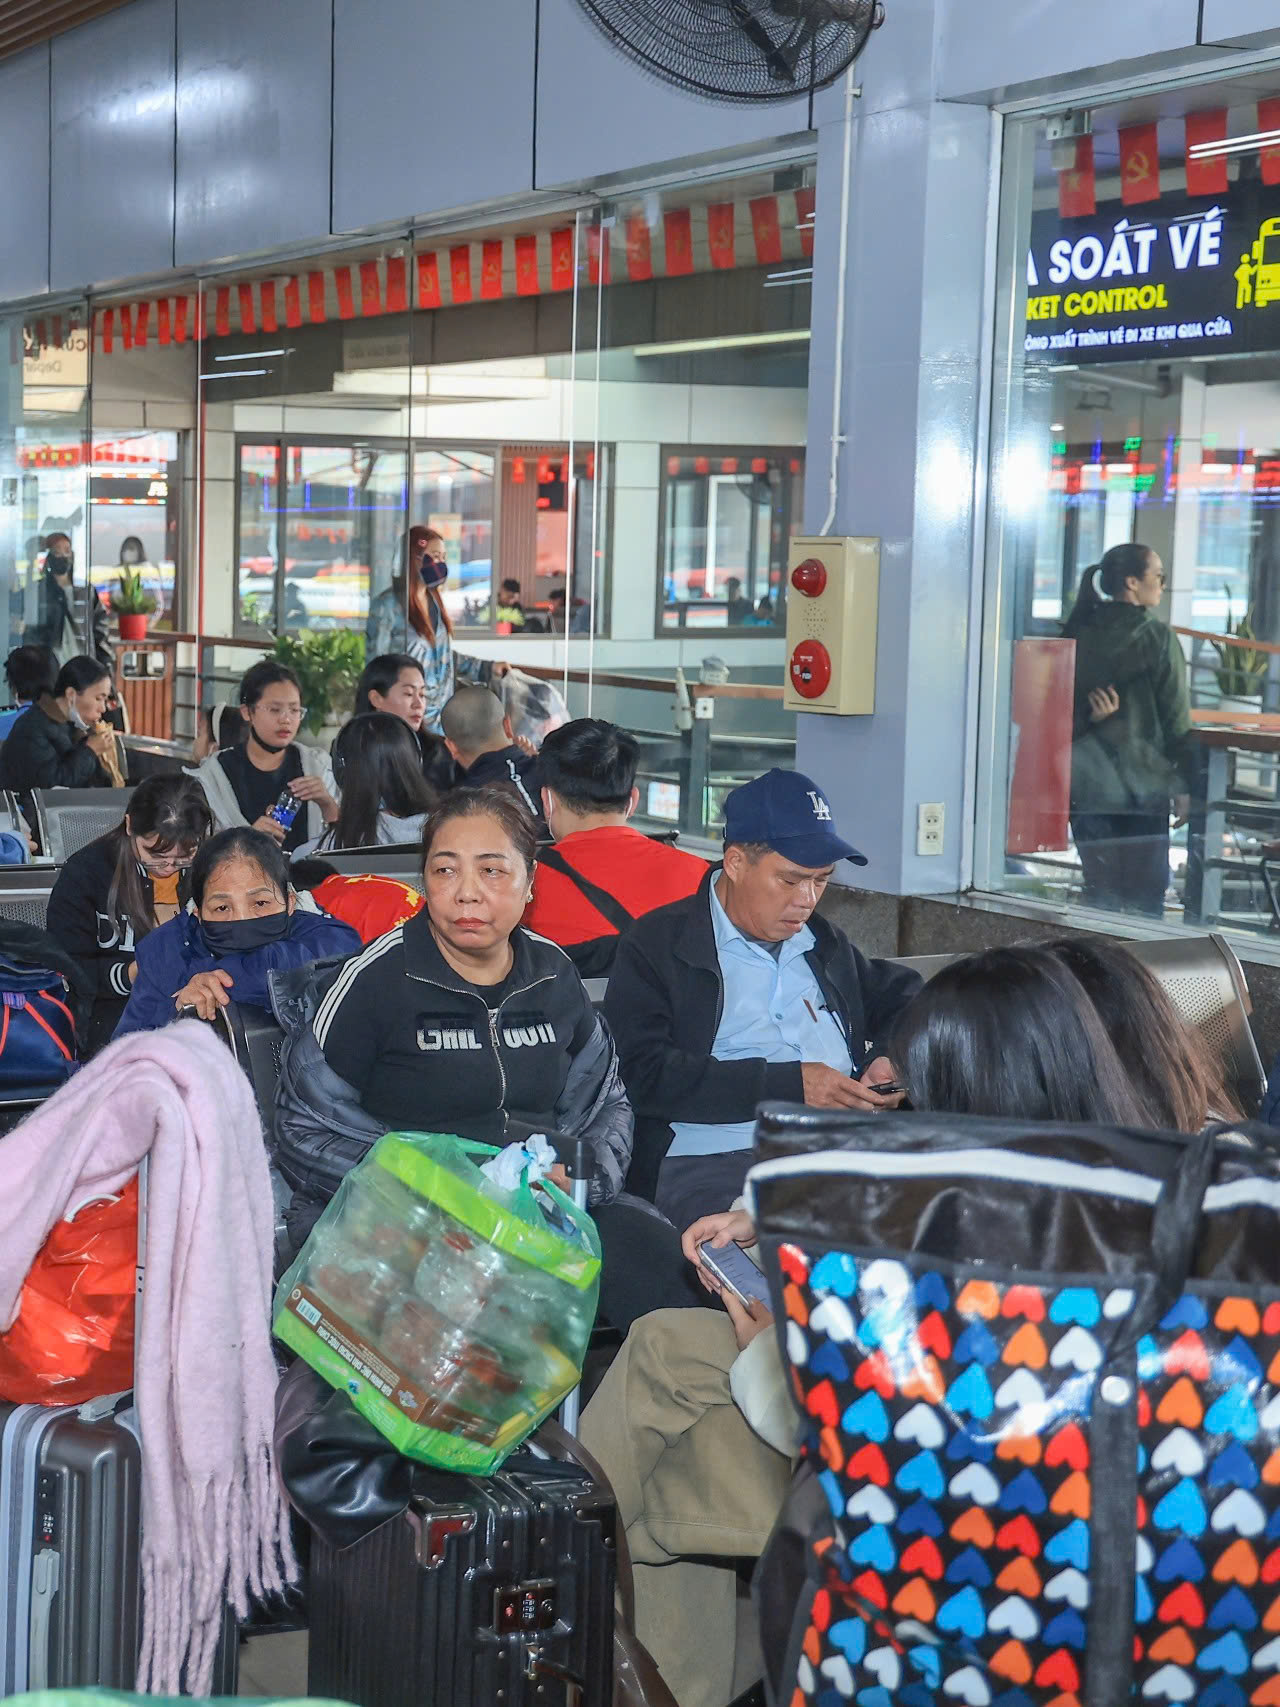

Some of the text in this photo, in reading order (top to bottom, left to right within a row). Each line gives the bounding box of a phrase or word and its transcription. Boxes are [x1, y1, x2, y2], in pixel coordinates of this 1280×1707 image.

[1048, 218, 1158, 284] SOÁT
[1168, 205, 1222, 270] VÉ
[1064, 284, 1168, 317] CONTROL
[1049, 328, 1077, 349] XUẤT
[1139, 326, 1155, 342] XE
[1155, 324, 1177, 340] KHI
[1177, 322, 1204, 338] QUA
